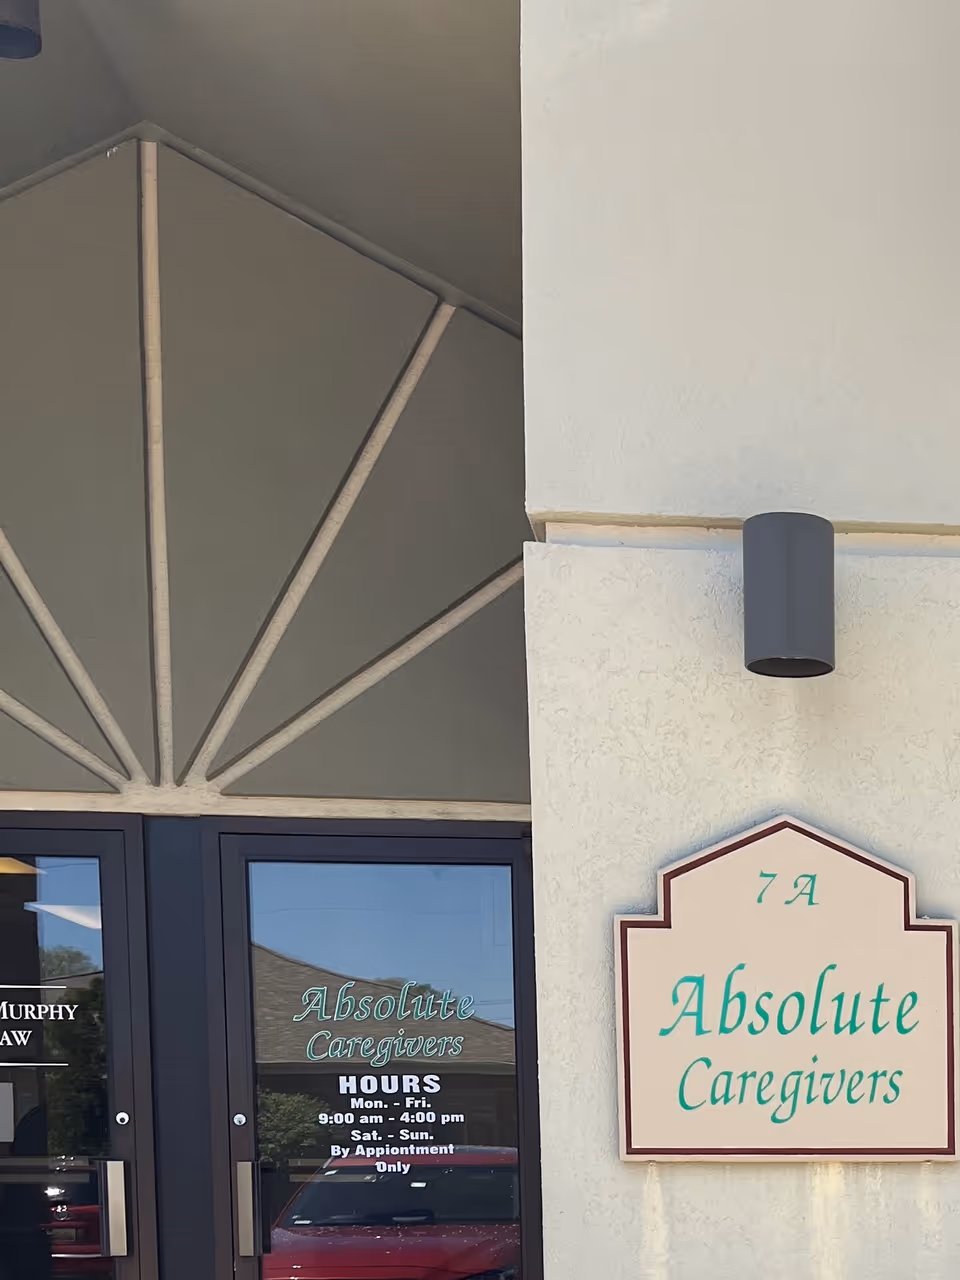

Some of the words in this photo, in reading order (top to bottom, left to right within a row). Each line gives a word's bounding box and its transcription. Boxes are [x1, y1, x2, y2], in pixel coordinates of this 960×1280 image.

[756, 869, 778, 904] 7
[784, 873, 820, 906] A
[292, 981, 475, 1022] Absolute
[658, 963, 920, 1037] Absolute
[306, 1028, 464, 1068] Caregivers
[338, 1075, 441, 1095] HOURS
[678, 1054, 904, 1124] Caregivers
[350, 1097, 388, 1109] Mon.
[405, 1097, 431, 1108] Fri.
[318, 1112, 354, 1125] 9:00
[359, 1114, 383, 1124] am
[399, 1111, 436, 1123] 4:00
[441, 1113, 465, 1125] pm
[350, 1129, 382, 1141] Sat.
[399, 1129, 434, 1141] Sun.
[330, 1145, 350, 1158] By
[355, 1143, 455, 1158] Appiontment
[375, 1161, 411, 1174] Only
